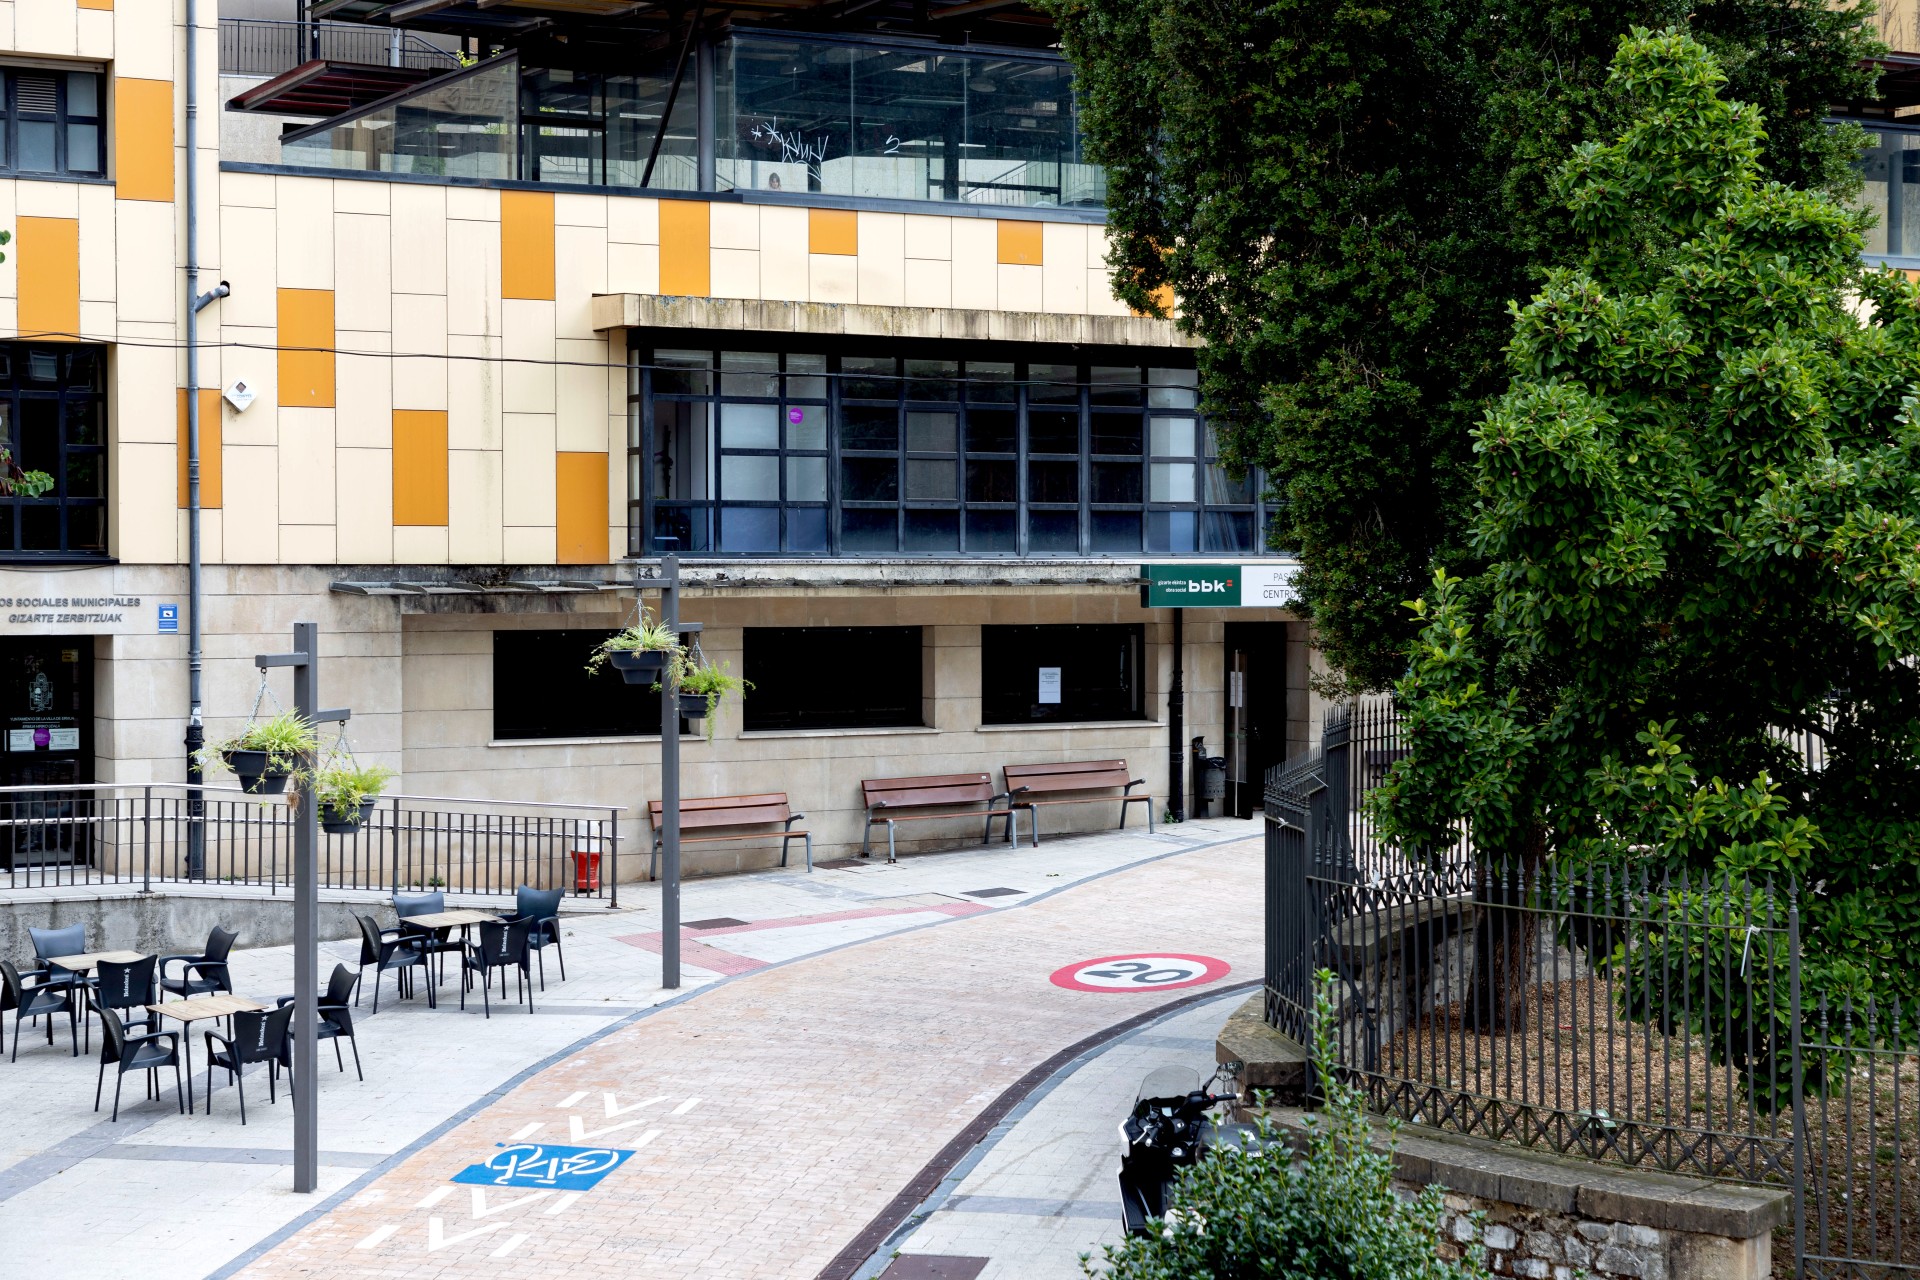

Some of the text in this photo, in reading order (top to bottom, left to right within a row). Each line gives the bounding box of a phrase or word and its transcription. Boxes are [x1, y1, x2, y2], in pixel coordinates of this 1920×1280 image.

[1188, 579, 1226, 593] bbk
[1263, 589, 1296, 599] CENTRO
[16, 597, 69, 607] SOCIALES
[71, 597, 141, 607] MUNICIPALES
[8, 613, 122, 623] GIZARTE ZERBITZUAK
[1083, 962, 1193, 984] 20
